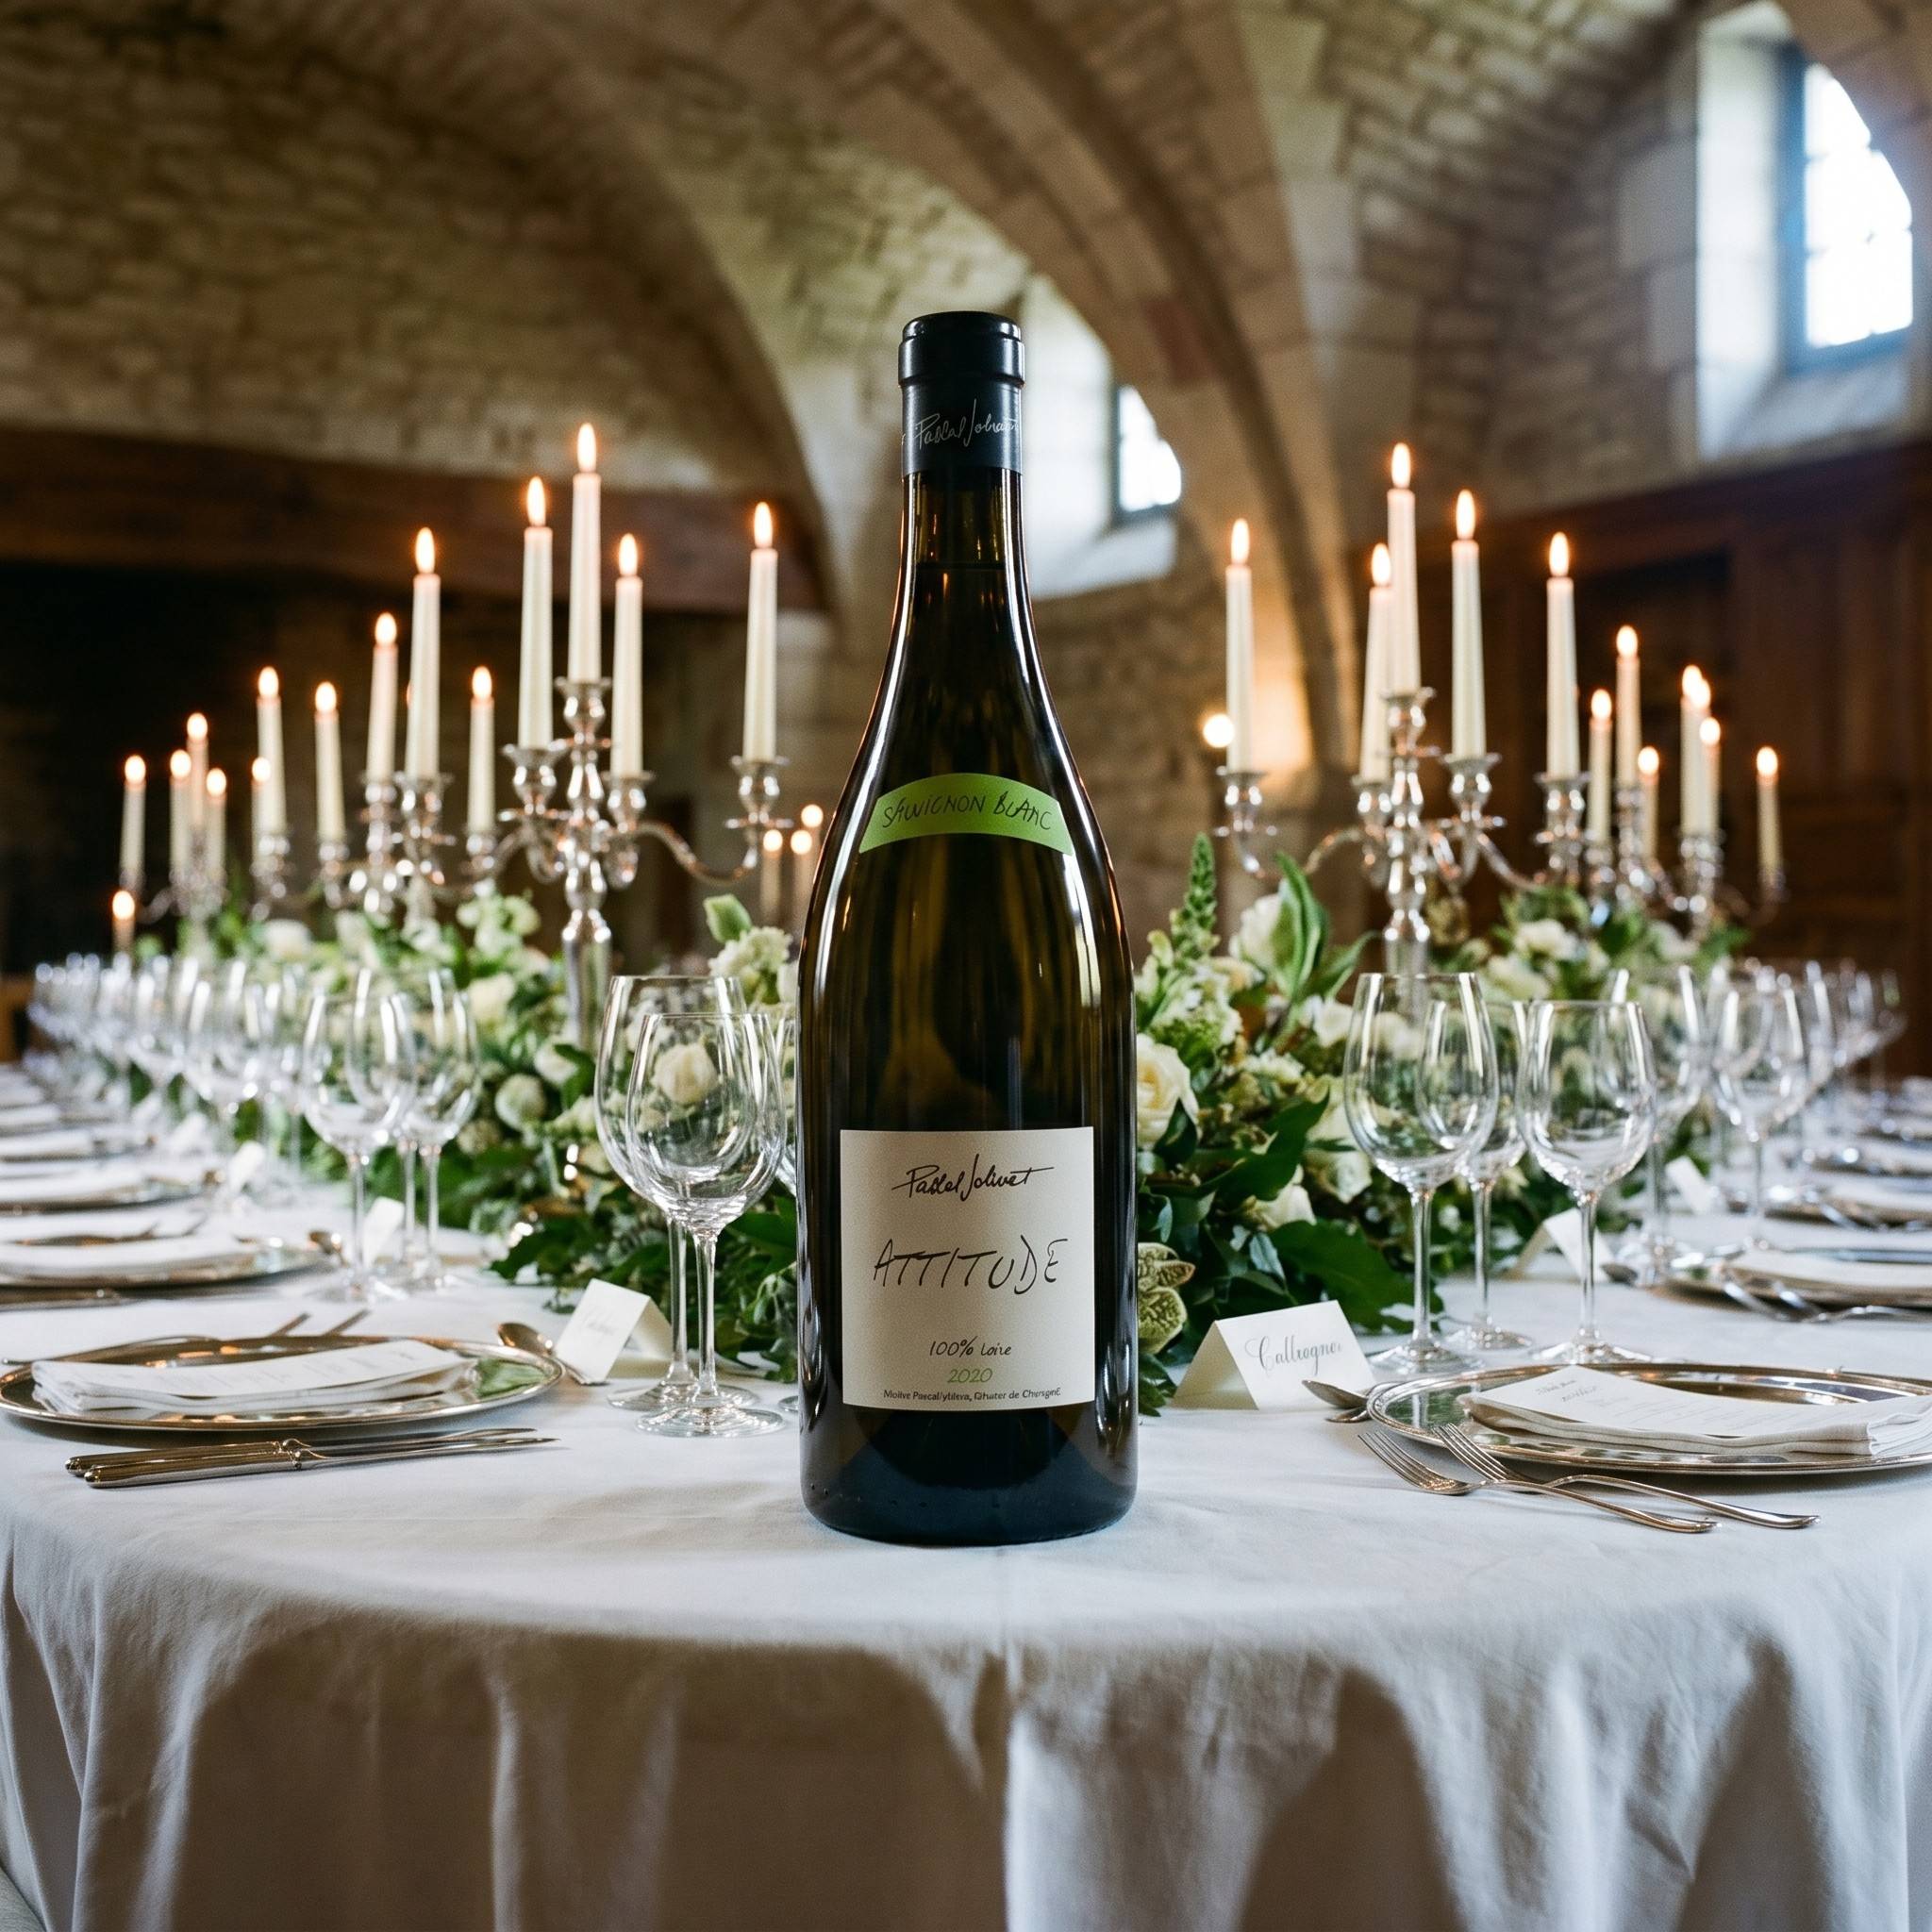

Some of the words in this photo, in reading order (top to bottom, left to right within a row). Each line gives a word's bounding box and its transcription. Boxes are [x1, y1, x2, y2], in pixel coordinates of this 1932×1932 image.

[993, 791, 1052, 830] BLANC
[874, 1234, 1068, 1294] ATTITUDE
[929, 1336, 978, 1357] 100%
[946, 1368, 993, 1384] 2020
[1008, 1390, 1020, 1399] de
